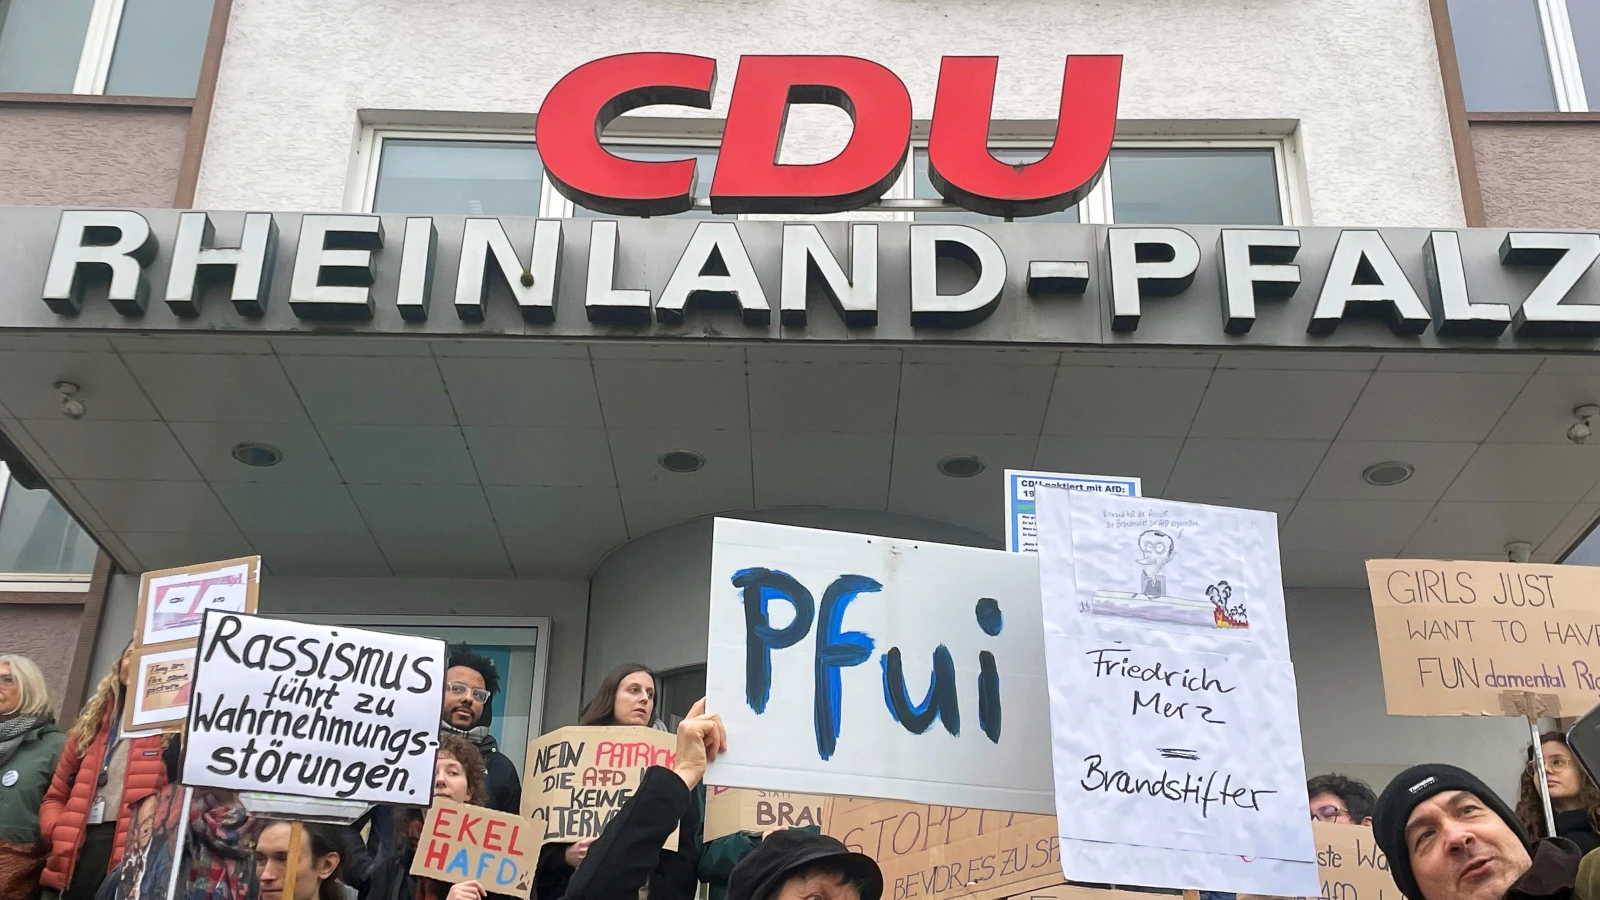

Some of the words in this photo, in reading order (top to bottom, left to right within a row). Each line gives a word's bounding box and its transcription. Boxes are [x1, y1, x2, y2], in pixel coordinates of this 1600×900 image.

[535, 52, 1123, 216] CDU
[41, 210, 1600, 337] RHEINLAND-PFALZ
[1086, 484, 1102, 492] mit
[1105, 485, 1125, 493] AfD:
[1388, 569, 1477, 604] GIRLS
[1493, 572, 1555, 608] JUST
[1406, 619, 1475, 642] WANT
[1492, 620, 1527, 644] TO
[204, 615, 434, 694] Rassismus
[1086, 649, 1237, 693] Friedrich
[264, 676, 339, 710] führt
[354, 693, 395, 717] zu
[1132, 691, 1225, 724] Merz
[193, 693, 438, 764] Wahrnehmungs-
[207, 739, 415, 798] störungen.
[533, 741, 585, 777] NEIN
[543, 772, 575, 793] DIE
[571, 788, 633, 809] KEINE
[1081, 754, 1277, 818] Brandstifter
[432, 808, 523, 856] EKEL
[424, 839, 517, 885] HAFD
[1000, 844, 1029, 876] ZU
